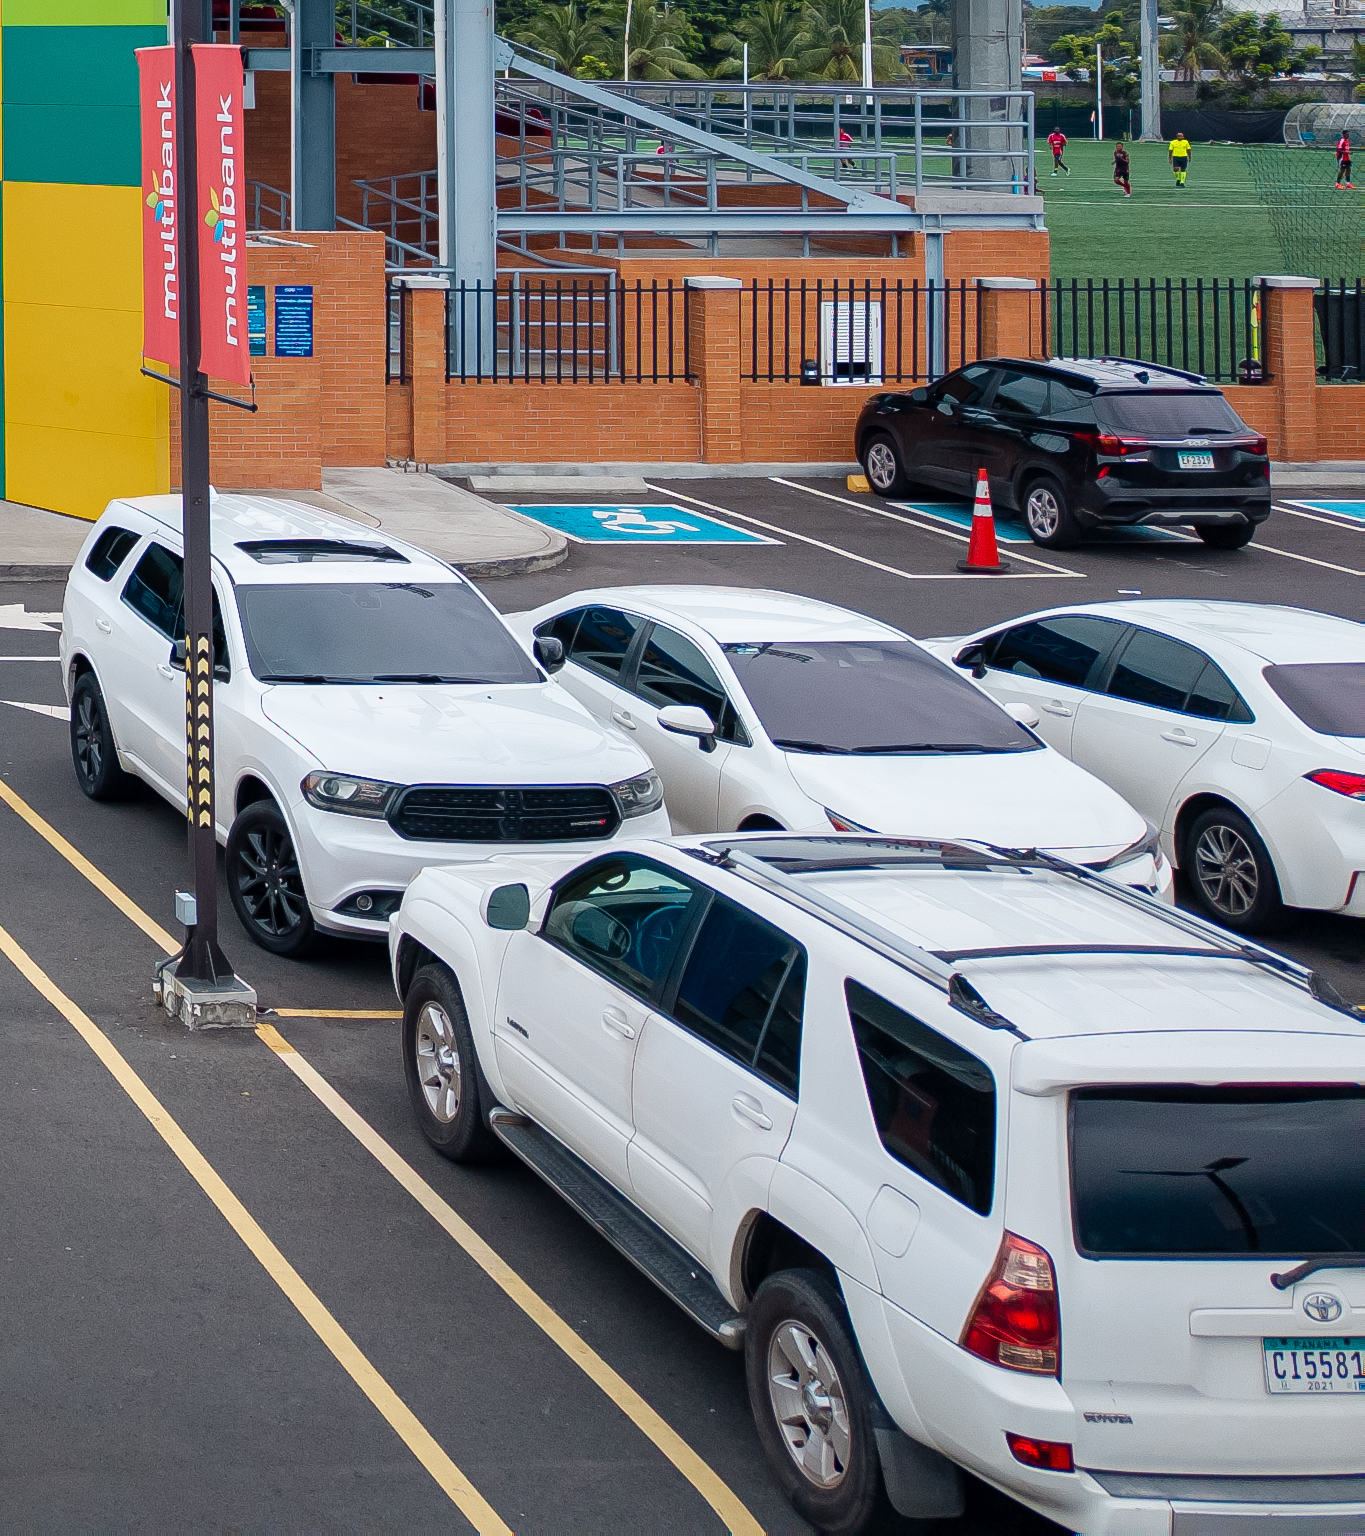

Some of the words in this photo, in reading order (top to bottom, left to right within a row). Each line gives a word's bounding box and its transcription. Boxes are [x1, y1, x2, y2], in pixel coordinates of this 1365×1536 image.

[156, 80, 177, 320] multibank
[217, 93, 238, 346] multibank
[1307, 1381, 1334, 1391] 2021
